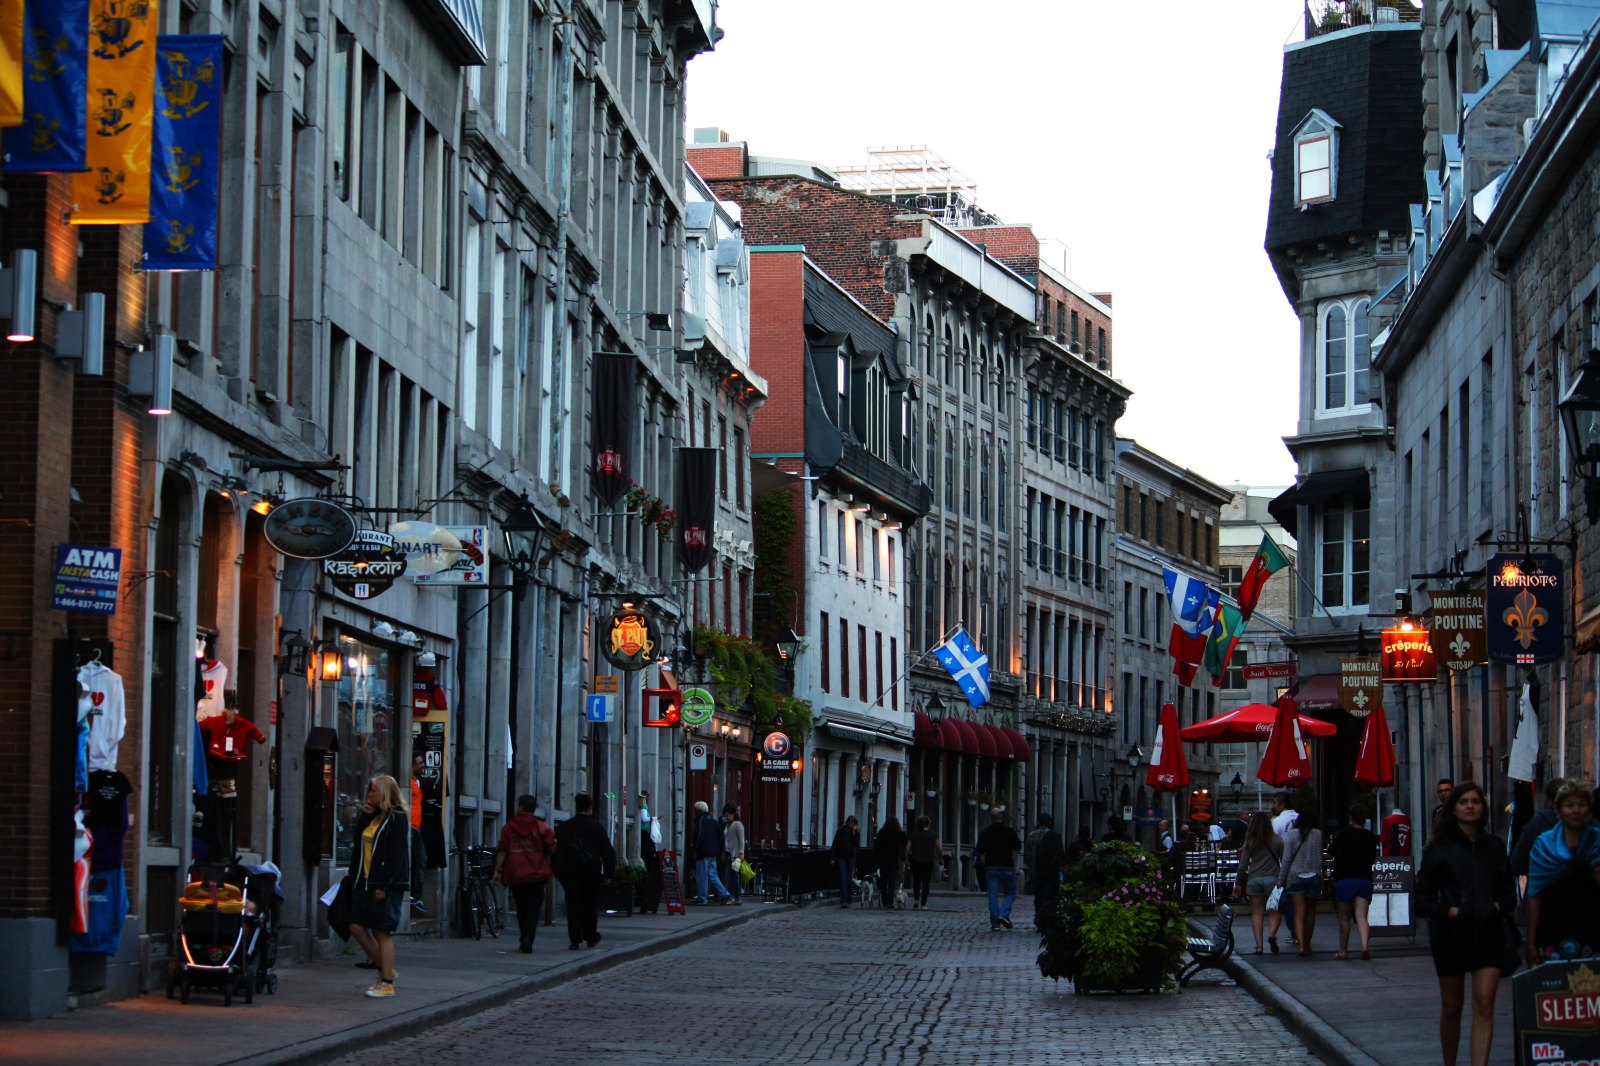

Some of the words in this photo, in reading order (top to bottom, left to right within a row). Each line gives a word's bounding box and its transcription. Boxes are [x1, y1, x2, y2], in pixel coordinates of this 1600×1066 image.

[64, 548, 115, 569] ATM
[1493, 575, 1558, 587] PATRIOTE
[54, 597, 114, 611] 1-866-837-0777
[1433, 594, 1484, 609] MONTRÉAL
[1434, 614, 1484, 630] POUTINE
[1384, 640, 1434, 654] crêperie
[1342, 662, 1380, 672] MONTRÉAL
[1342, 676, 1379, 688] POUTINE
[1372, 861, 1411, 873] rêperie
[1533, 1043, 1564, 1058] Mr.
